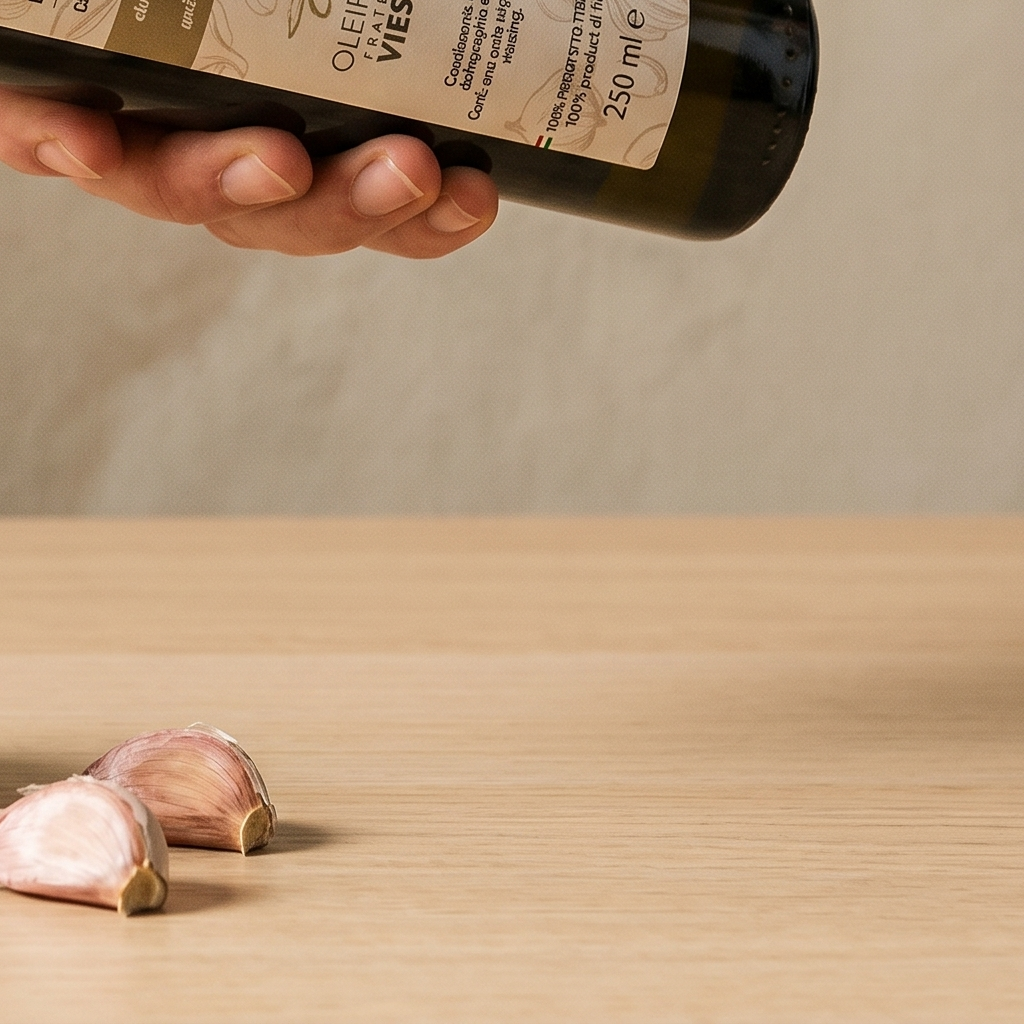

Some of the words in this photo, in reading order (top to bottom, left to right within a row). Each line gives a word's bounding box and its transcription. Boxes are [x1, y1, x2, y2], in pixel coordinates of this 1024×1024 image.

[565, 92, 587, 128] 100%
[580, 30, 601, 90] product
[603, 73, 635, 121] 250
[619, 34, 643, 68] ml
